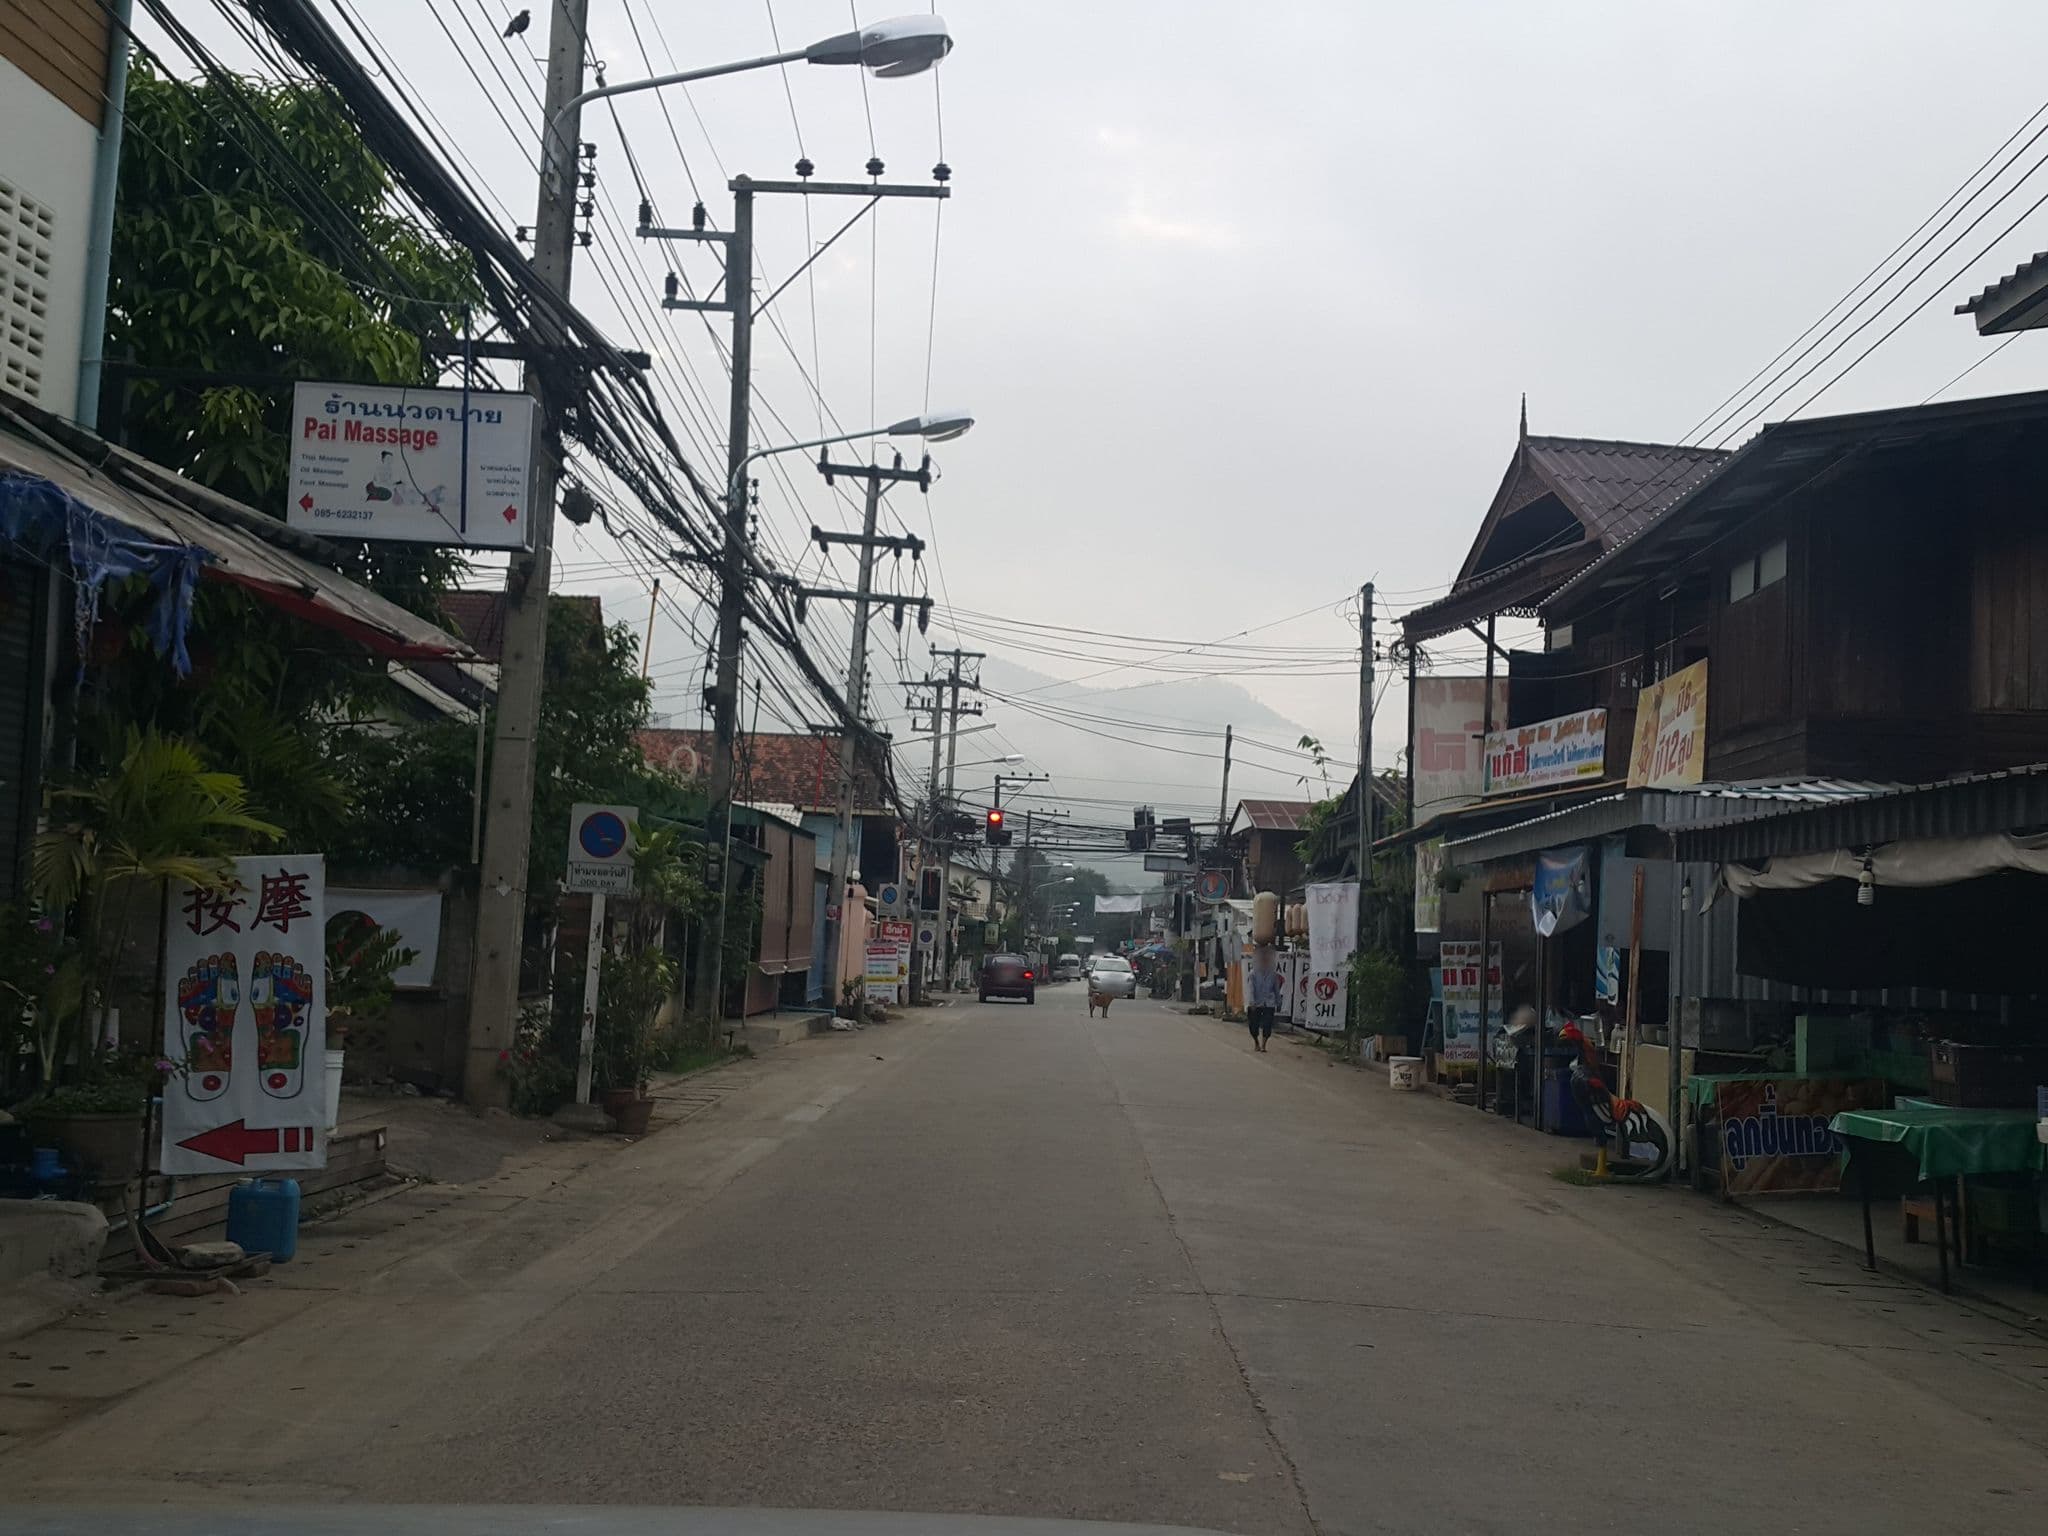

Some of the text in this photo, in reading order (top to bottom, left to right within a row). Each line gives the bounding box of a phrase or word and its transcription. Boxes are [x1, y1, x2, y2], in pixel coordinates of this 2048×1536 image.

[304, 417, 439, 451] Pai Massage
[182, 868, 313, 936] 按摩
[1315, 1003, 1336, 1017] SHI
[1724, 1083, 1842, 1172] ลูกชิ้นทอ
